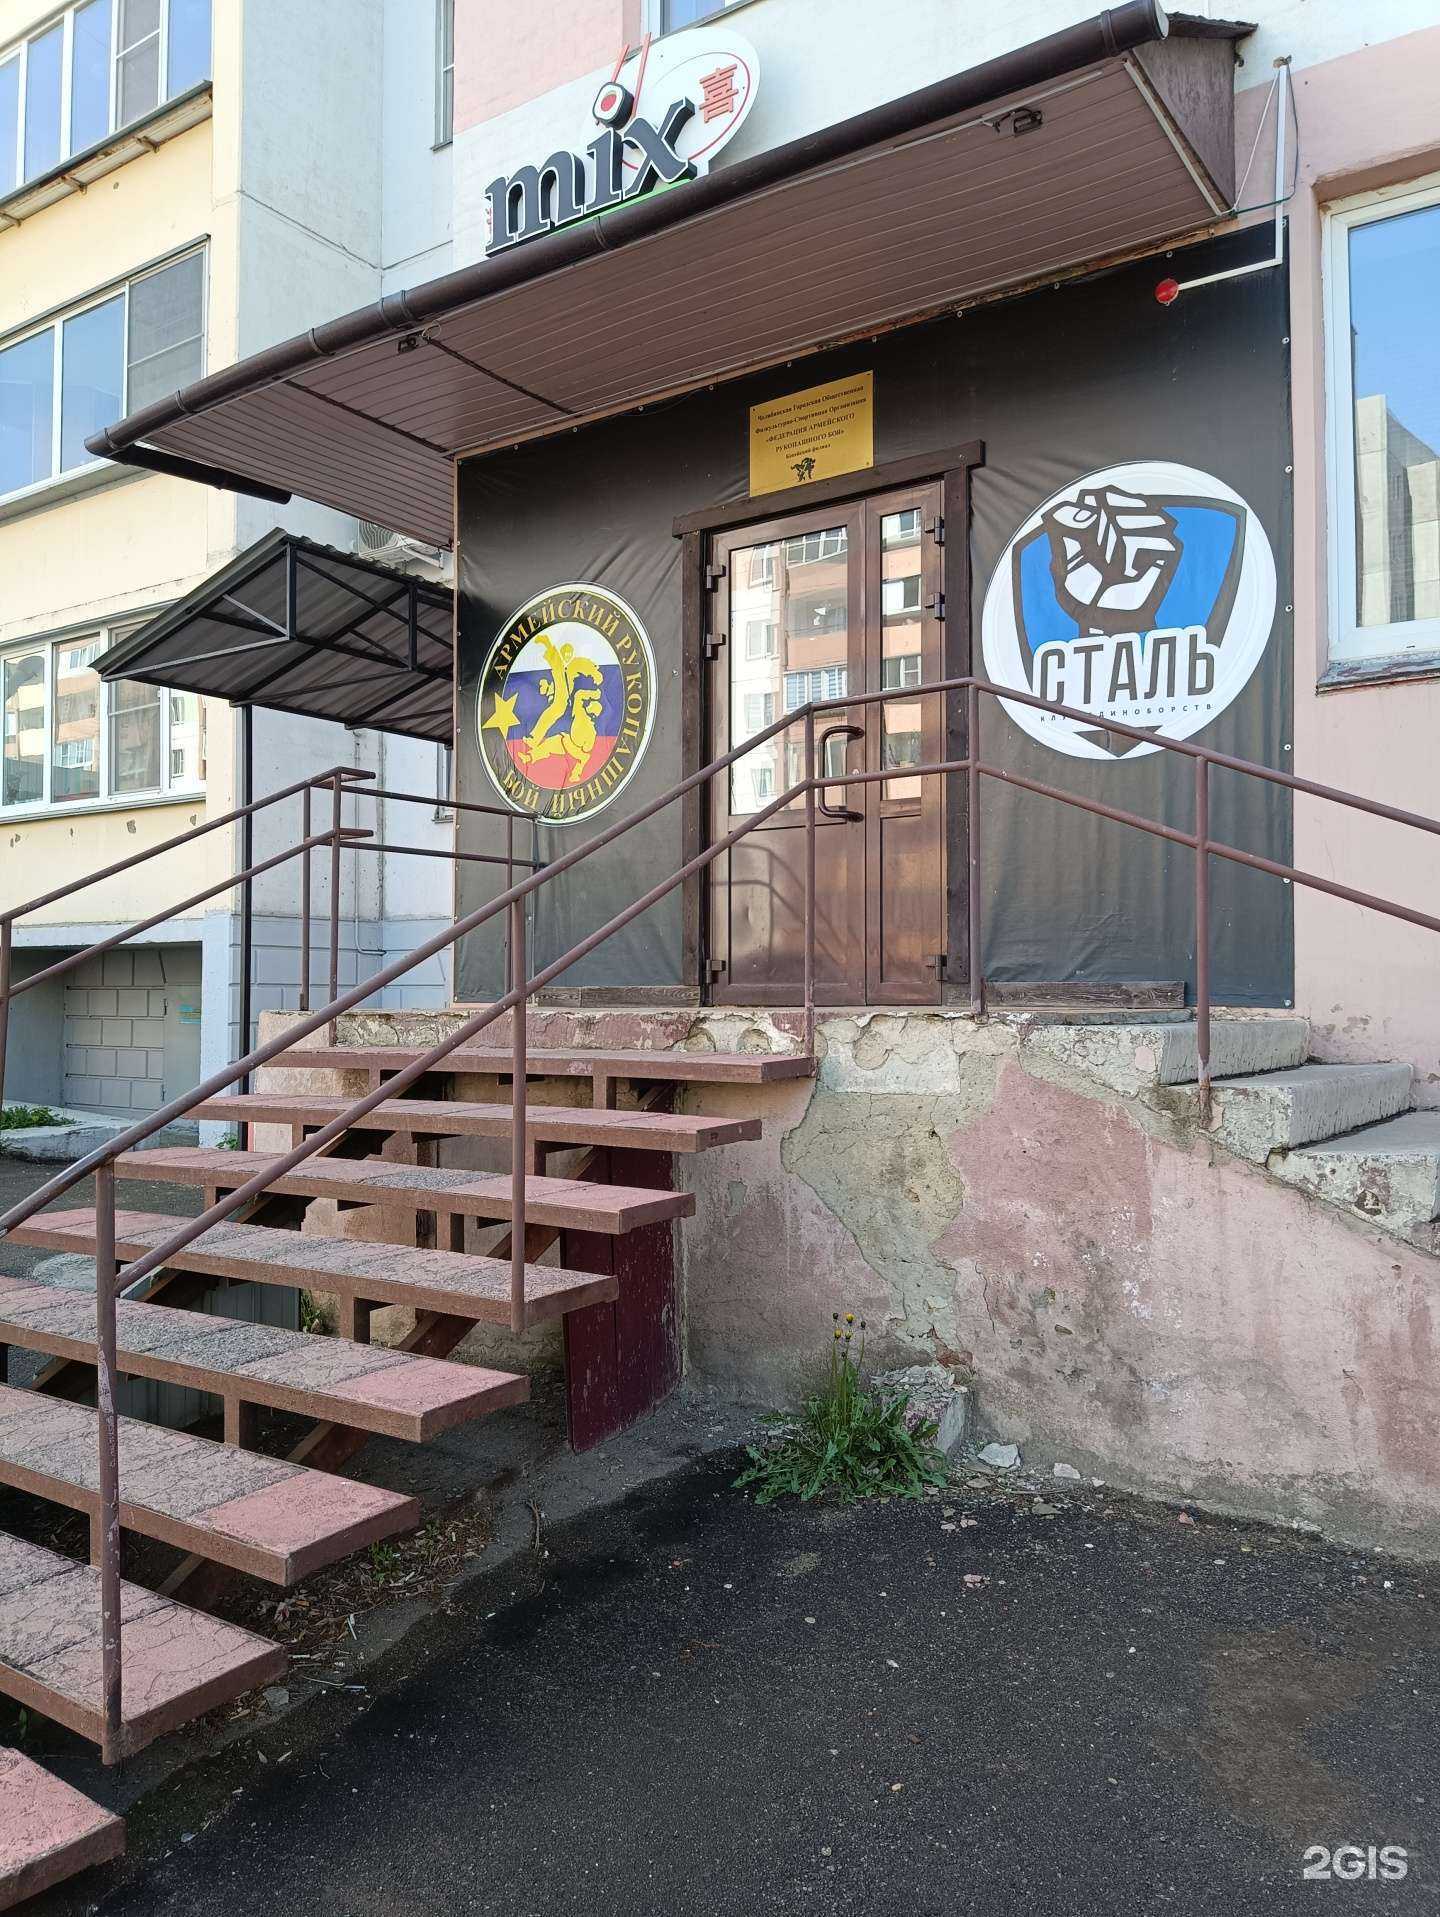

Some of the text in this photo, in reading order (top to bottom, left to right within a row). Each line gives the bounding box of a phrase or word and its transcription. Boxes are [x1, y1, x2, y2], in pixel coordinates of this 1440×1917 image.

[485, 82, 697, 257] mix
[1039, 633, 1215, 706] СТАЛЬ
[494, 599, 643, 819] АРМЕЙСКИЙ РУКОПАШНЫЙ
[1088, 703, 1213, 718] ДИНОБОРСТВ
[502, 770, 540, 810] БОЙ
